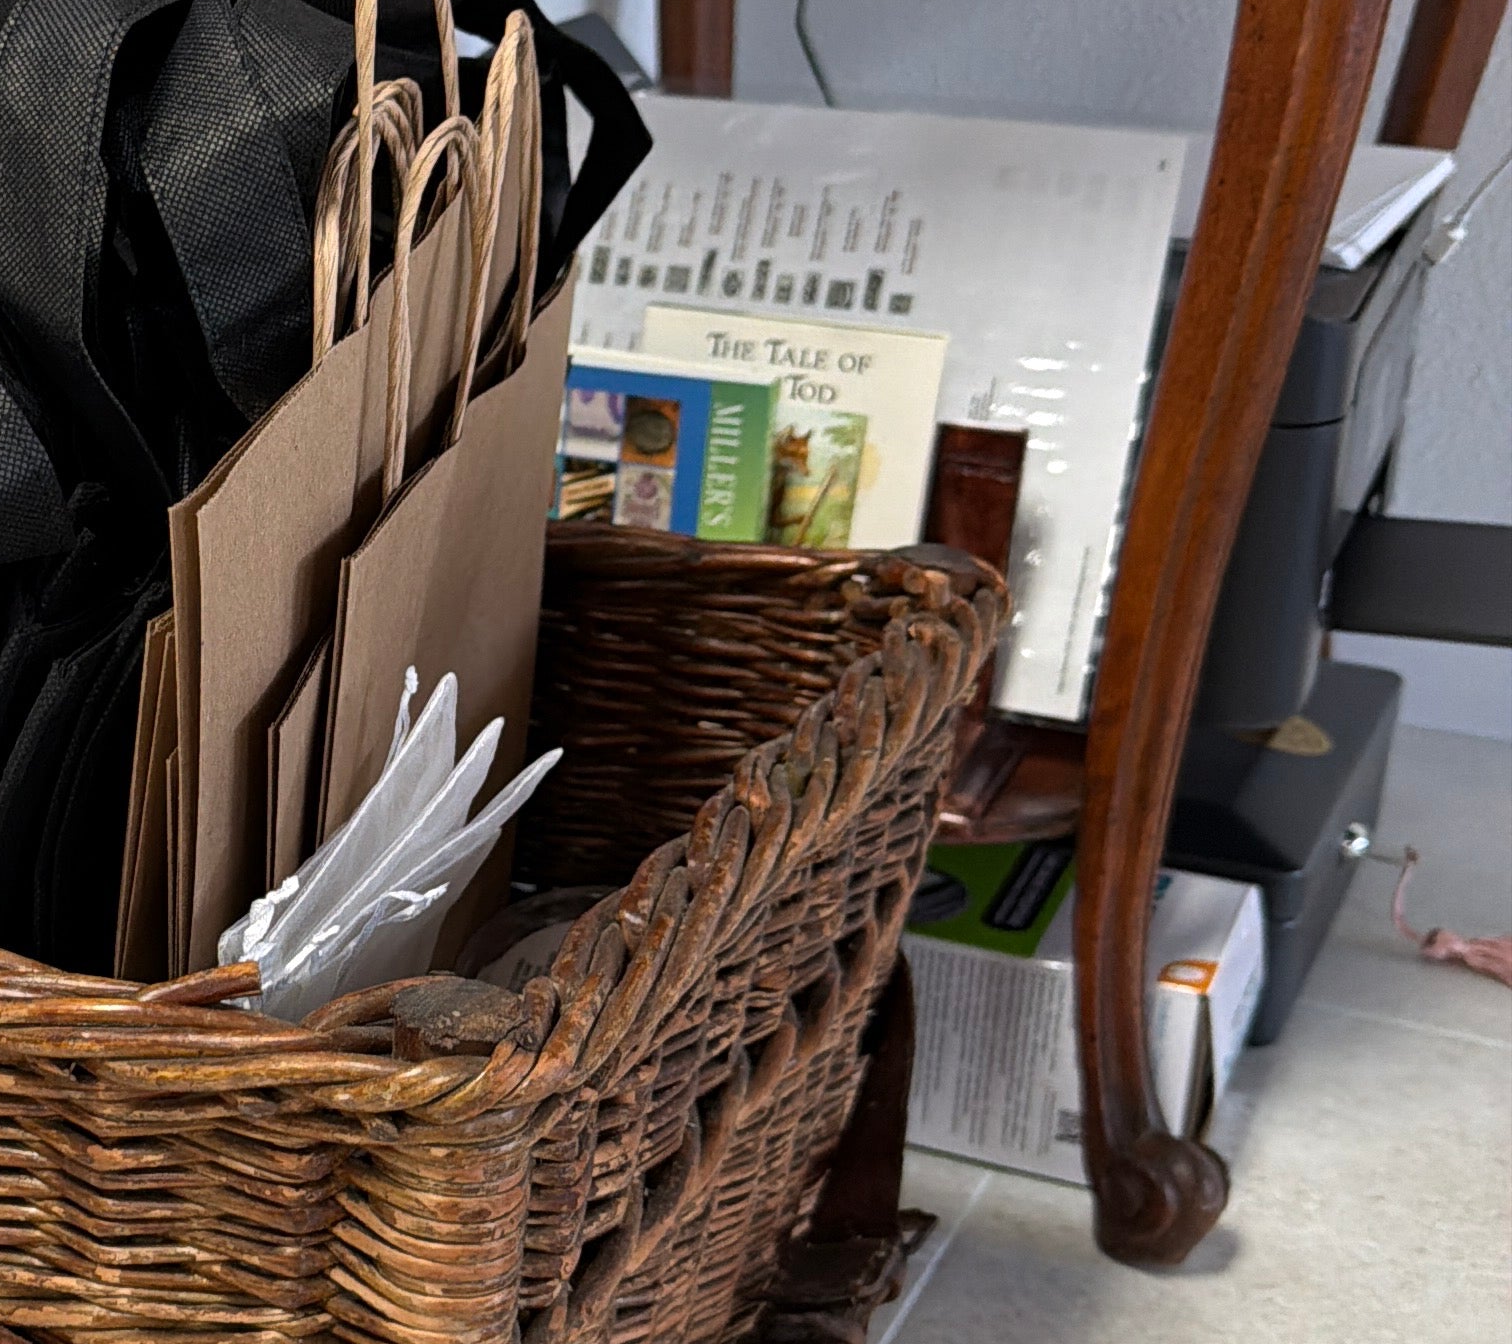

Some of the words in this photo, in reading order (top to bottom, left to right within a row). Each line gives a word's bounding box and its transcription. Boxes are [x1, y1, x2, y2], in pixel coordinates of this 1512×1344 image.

[706, 331, 757, 361] THE
[764, 338, 830, 371] TALE
[838, 352, 875, 375] OF
[785, 374, 840, 405] TOD
